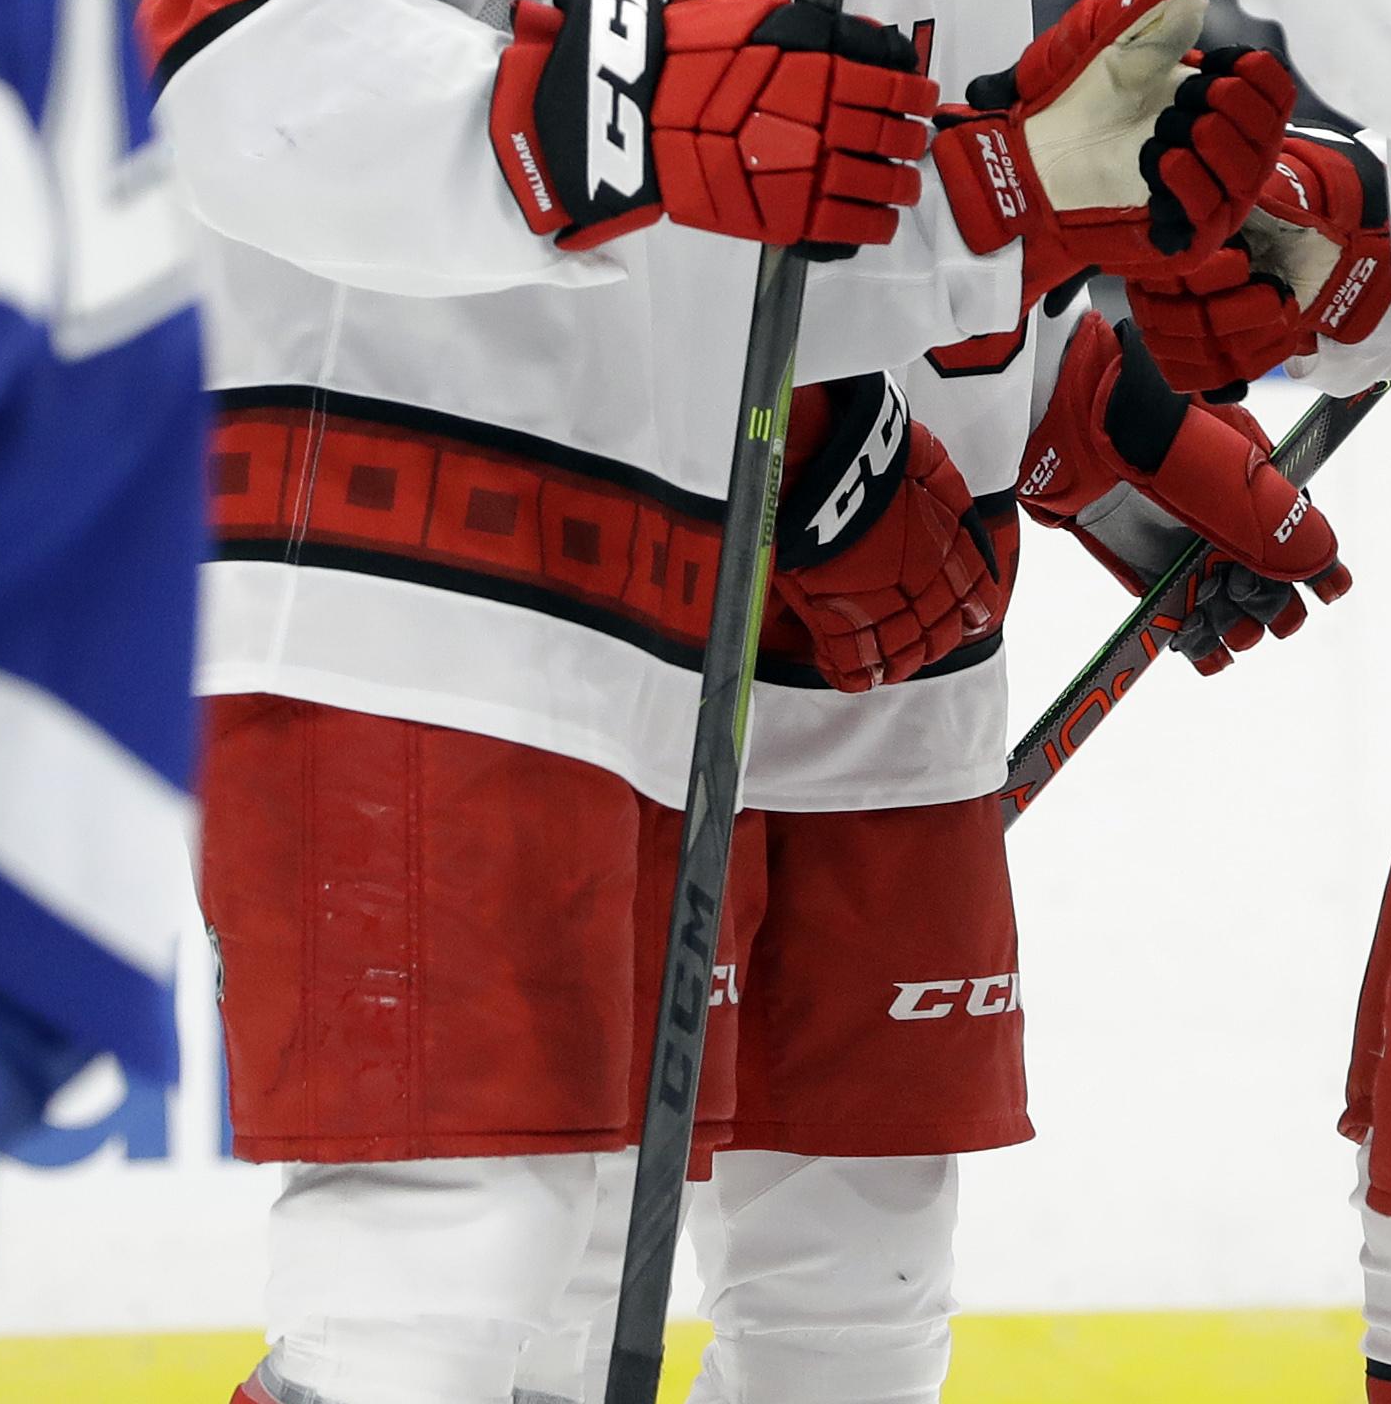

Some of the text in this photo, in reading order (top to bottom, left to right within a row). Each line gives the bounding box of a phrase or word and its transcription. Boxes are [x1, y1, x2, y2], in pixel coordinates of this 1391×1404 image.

[511, 132, 552, 212] WALLMARK
[975, 133, 1017, 218] CCM
[1328, 257, 1377, 329] CCM
[1021, 446, 1057, 495] CCM
[661, 880, 716, 1115] CCM
